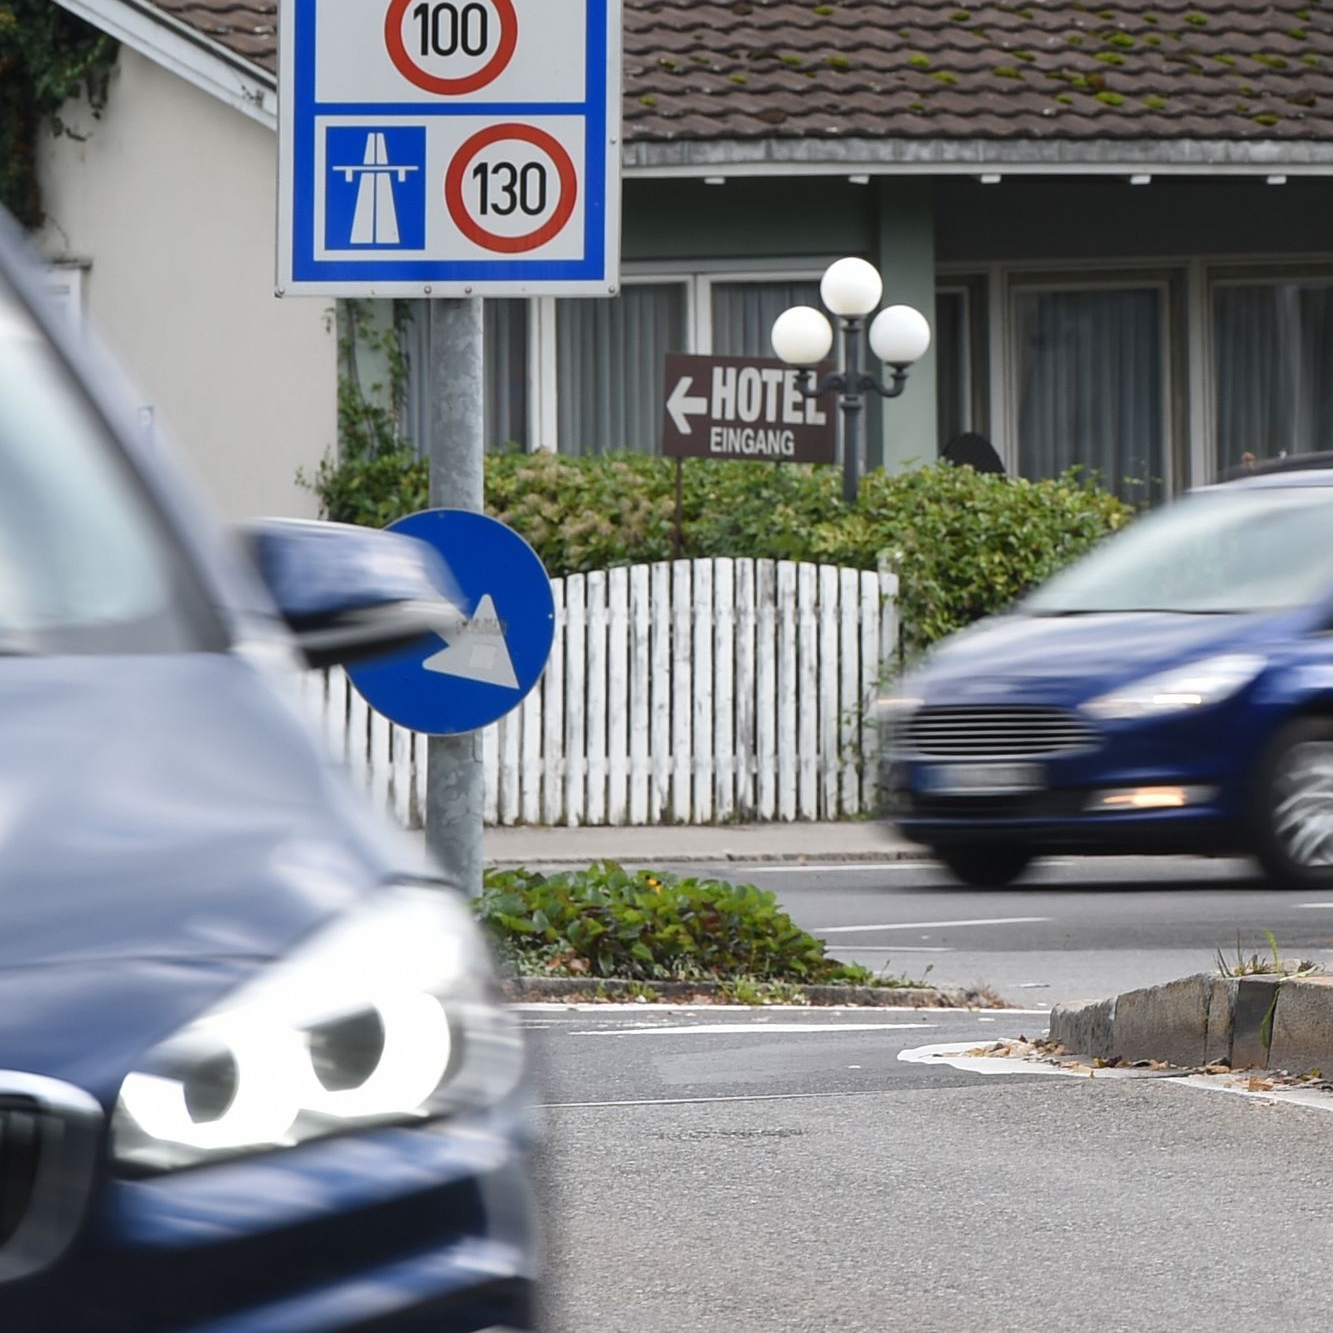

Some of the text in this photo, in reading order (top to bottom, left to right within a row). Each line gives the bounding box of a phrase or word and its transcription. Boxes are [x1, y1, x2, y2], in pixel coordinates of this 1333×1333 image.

[413, 2, 489, 57] 100
[472, 161, 547, 216] 130
[711, 366, 826, 426] HOTEL
[710, 426, 795, 456] EINGANG
